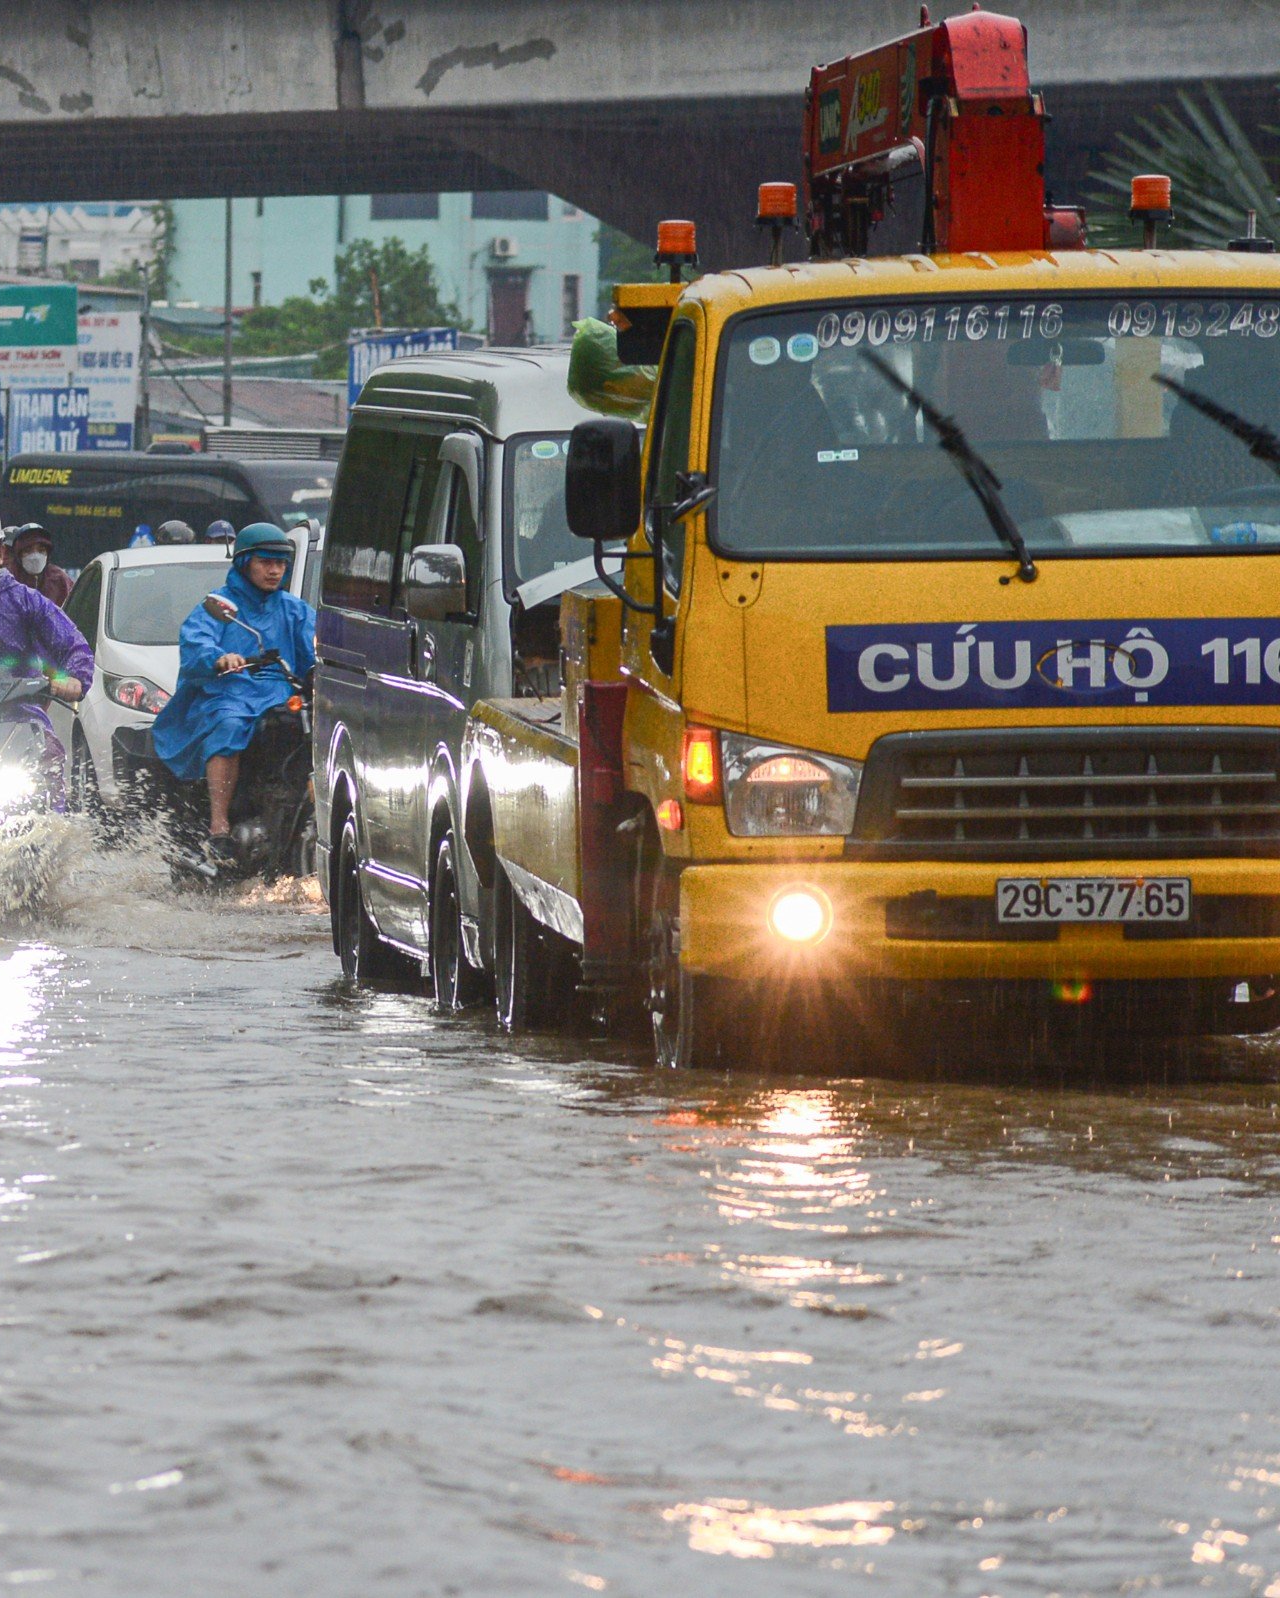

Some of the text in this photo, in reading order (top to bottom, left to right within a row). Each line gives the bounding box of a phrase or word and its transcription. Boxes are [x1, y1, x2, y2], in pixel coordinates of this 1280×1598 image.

[816, 303, 1064, 348] 0909116116
[13, 393, 54, 423] TRẠM
[57, 389, 89, 417] CÂN
[9, 469, 72, 485] LIMOUSINE
[857, 624, 1031, 693] CỨU
[1056, 627, 1170, 702] HỘ
